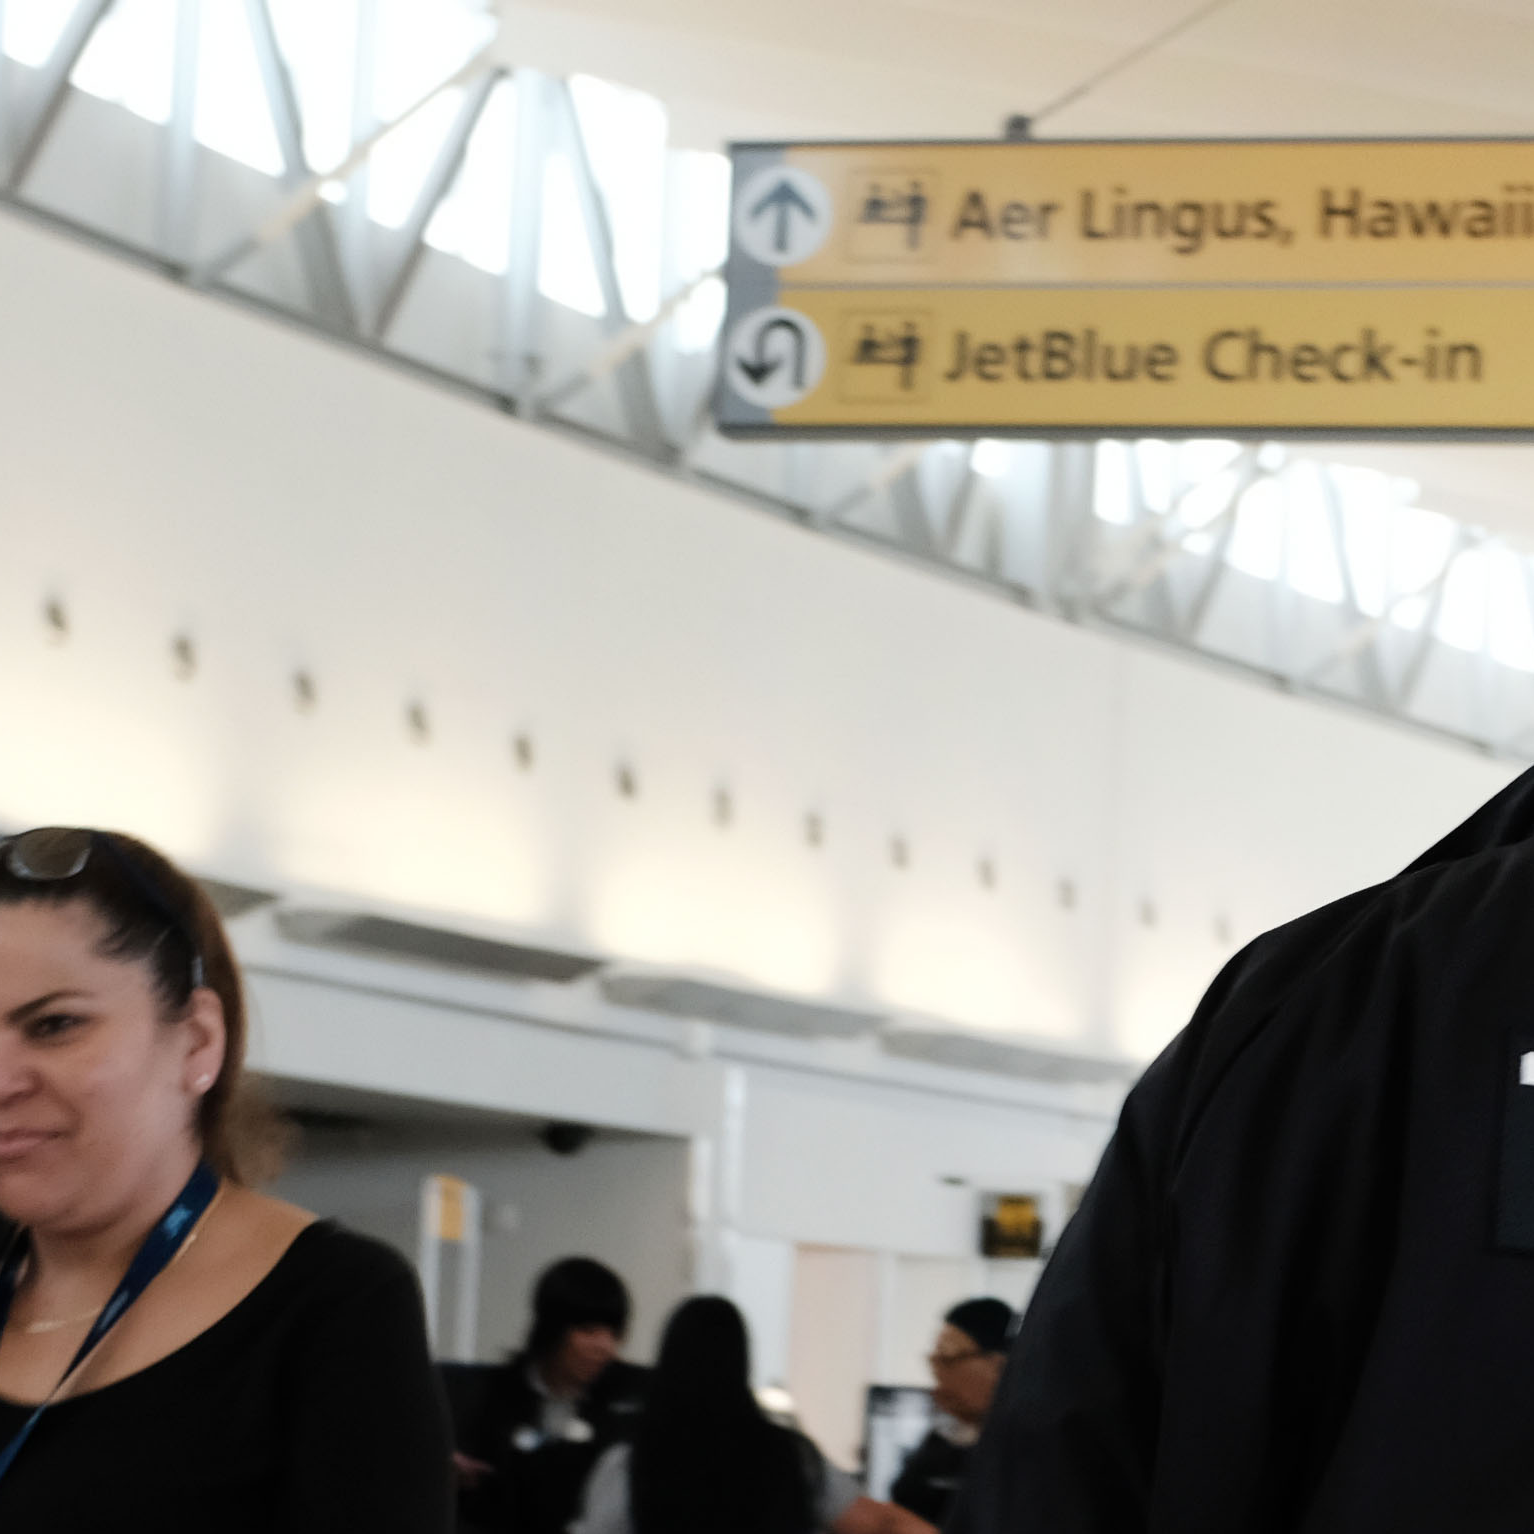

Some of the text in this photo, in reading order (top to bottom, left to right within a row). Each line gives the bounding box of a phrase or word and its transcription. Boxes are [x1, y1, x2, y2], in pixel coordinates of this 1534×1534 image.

[952, 188, 1060, 240] Aer
[1079, 184, 1296, 256] Lingus,
[943, 327, 1483, 383] JetBlue Check-in
